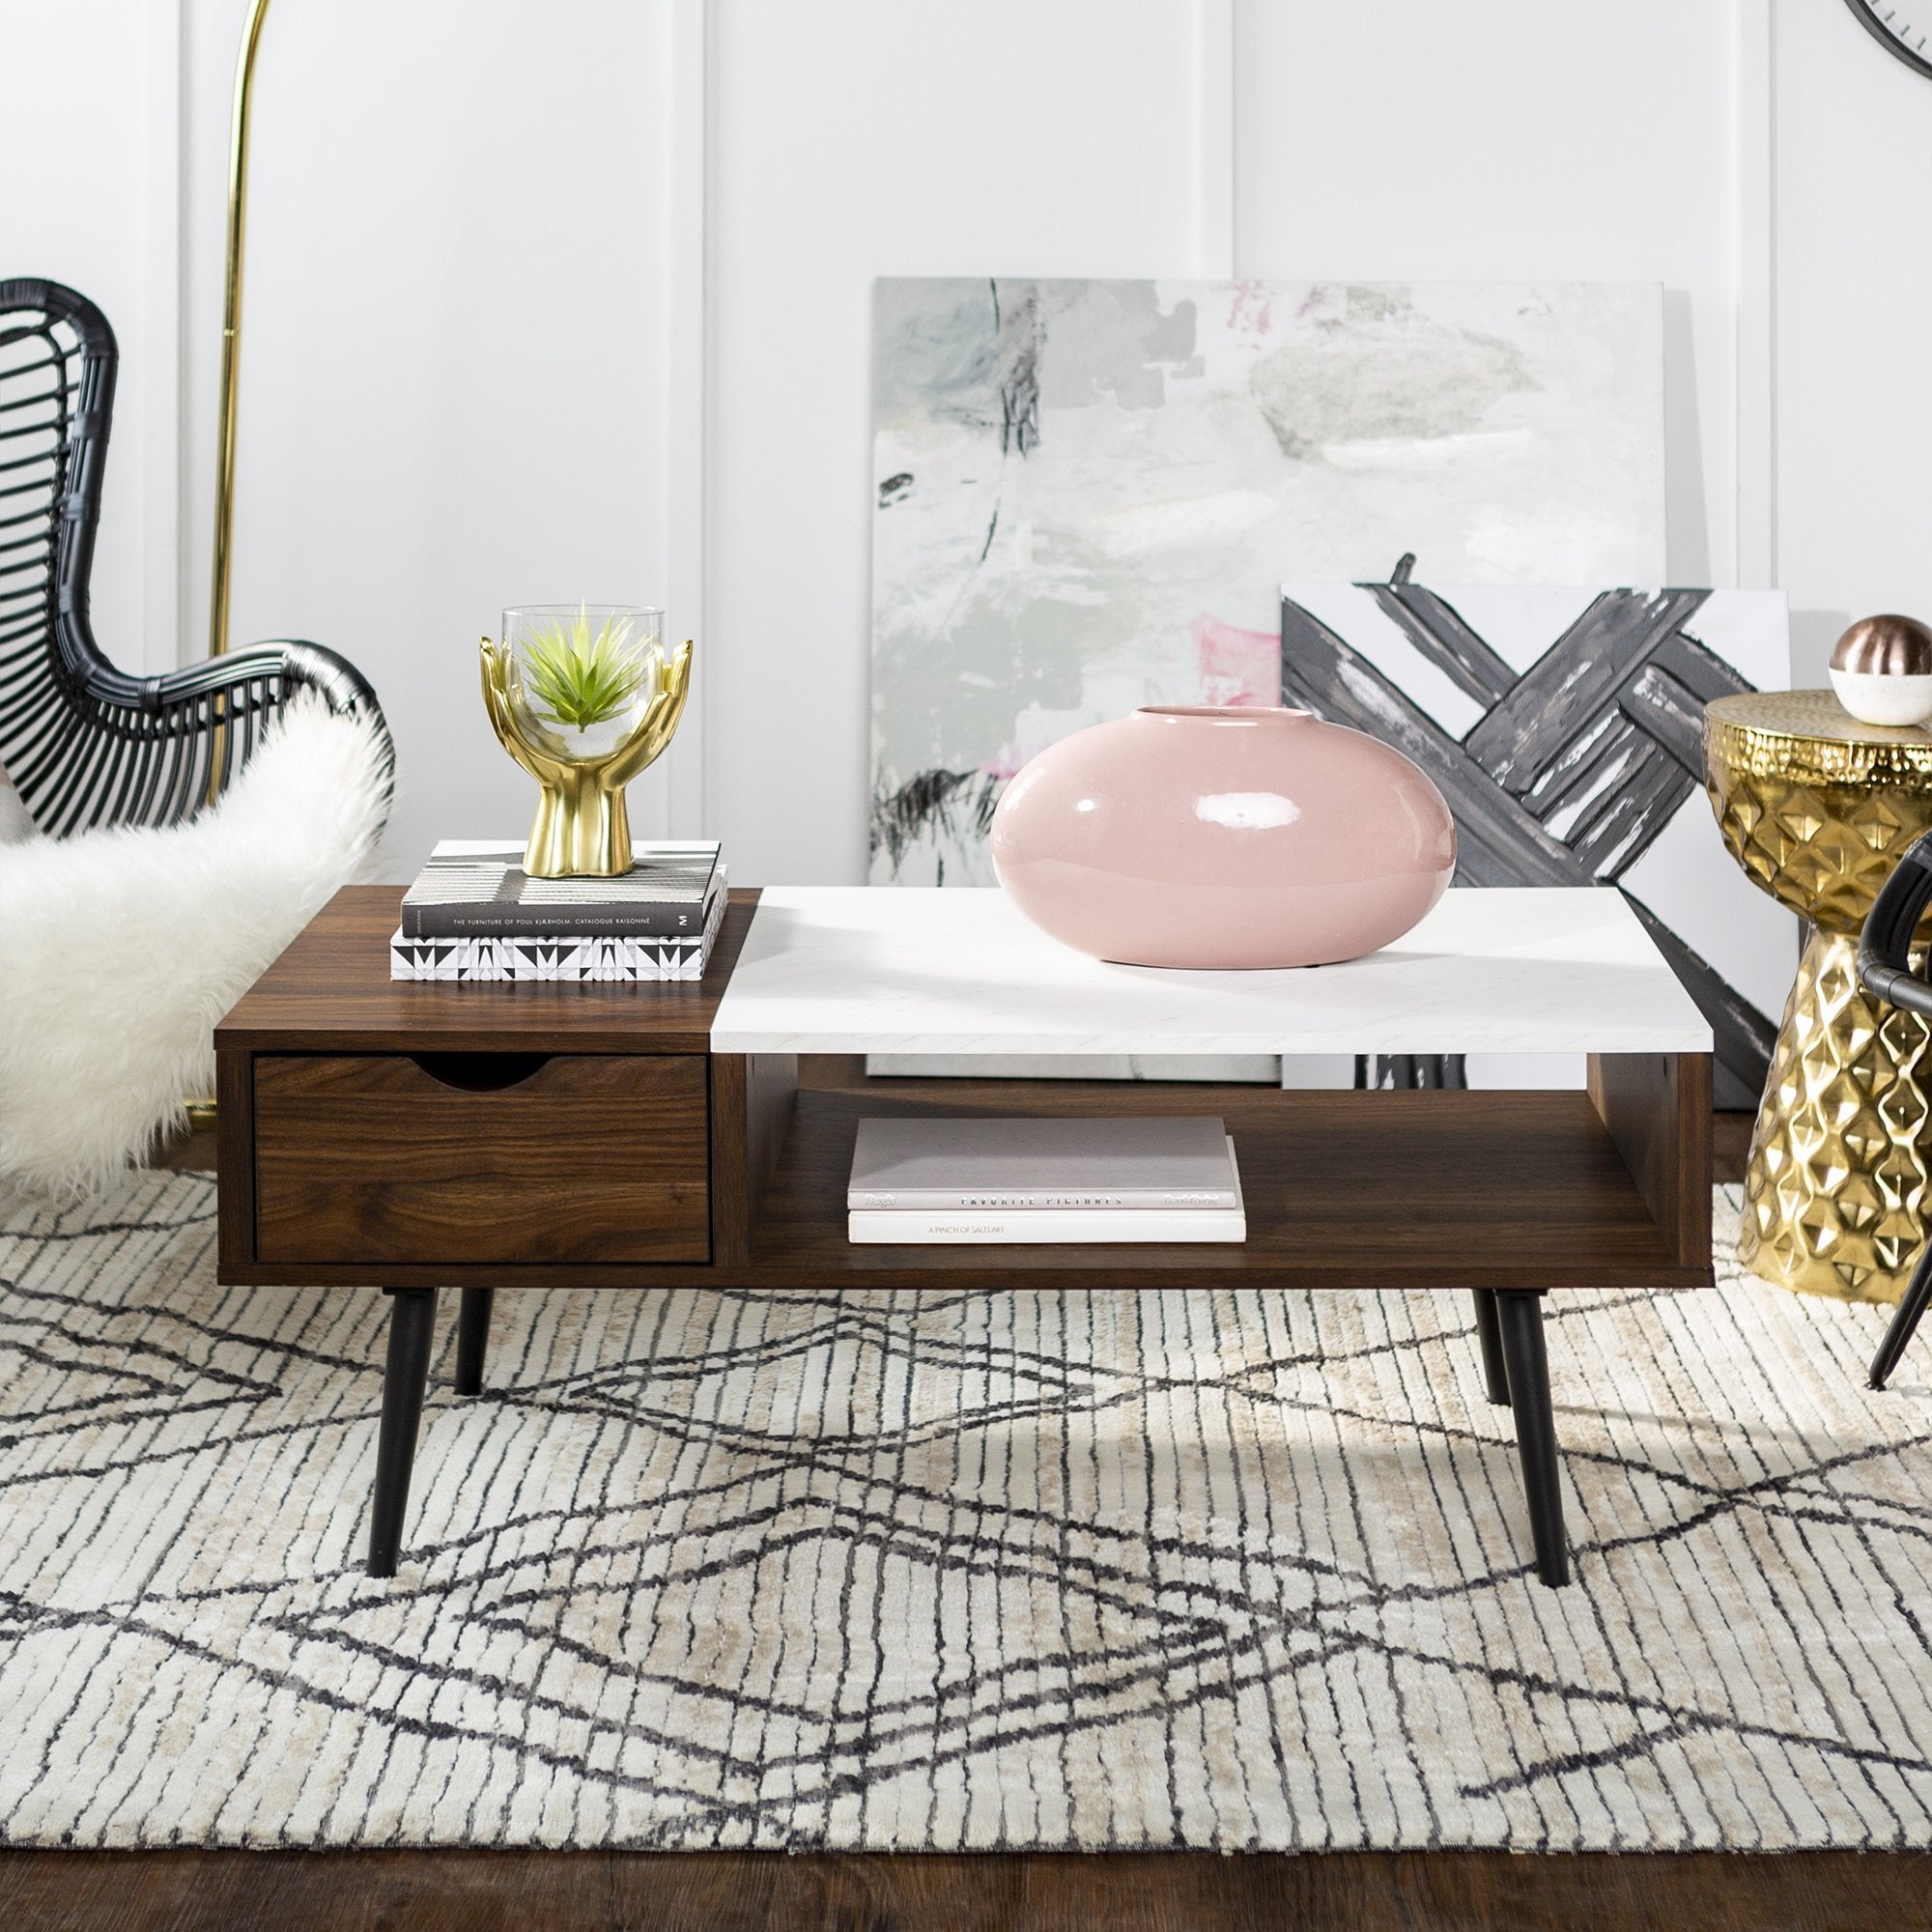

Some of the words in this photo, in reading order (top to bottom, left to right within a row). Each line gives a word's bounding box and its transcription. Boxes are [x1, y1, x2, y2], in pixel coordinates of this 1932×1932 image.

[678, 915, 688, 926] M
[960, 1196, 1035, 1206] FAVORITE
[1046, 1196, 1122, 1206] PICTURES
